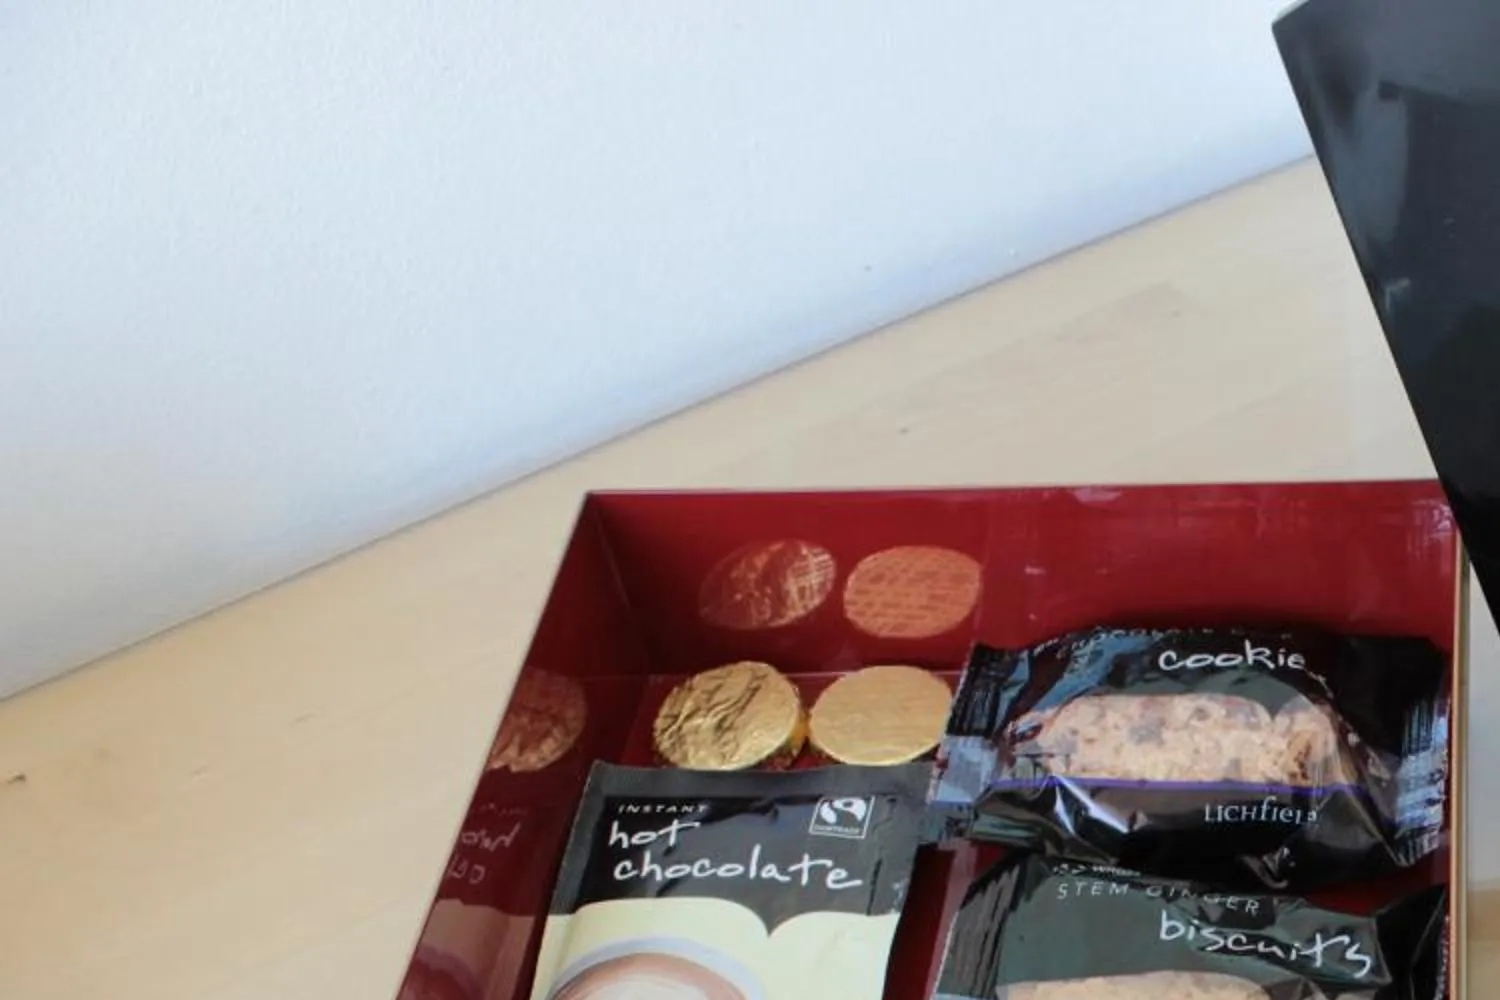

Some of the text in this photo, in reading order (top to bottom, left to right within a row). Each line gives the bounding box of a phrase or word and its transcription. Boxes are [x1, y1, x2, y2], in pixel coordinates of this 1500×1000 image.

[1158, 639, 1305, 671] cookie
[617, 801, 710, 816] INSTANT
[608, 818, 700, 850] hot
[612, 843, 863, 891] chocolate
[1057, 880, 1262, 917] STEM GINGER
[1158, 910, 1373, 979] biscuits
